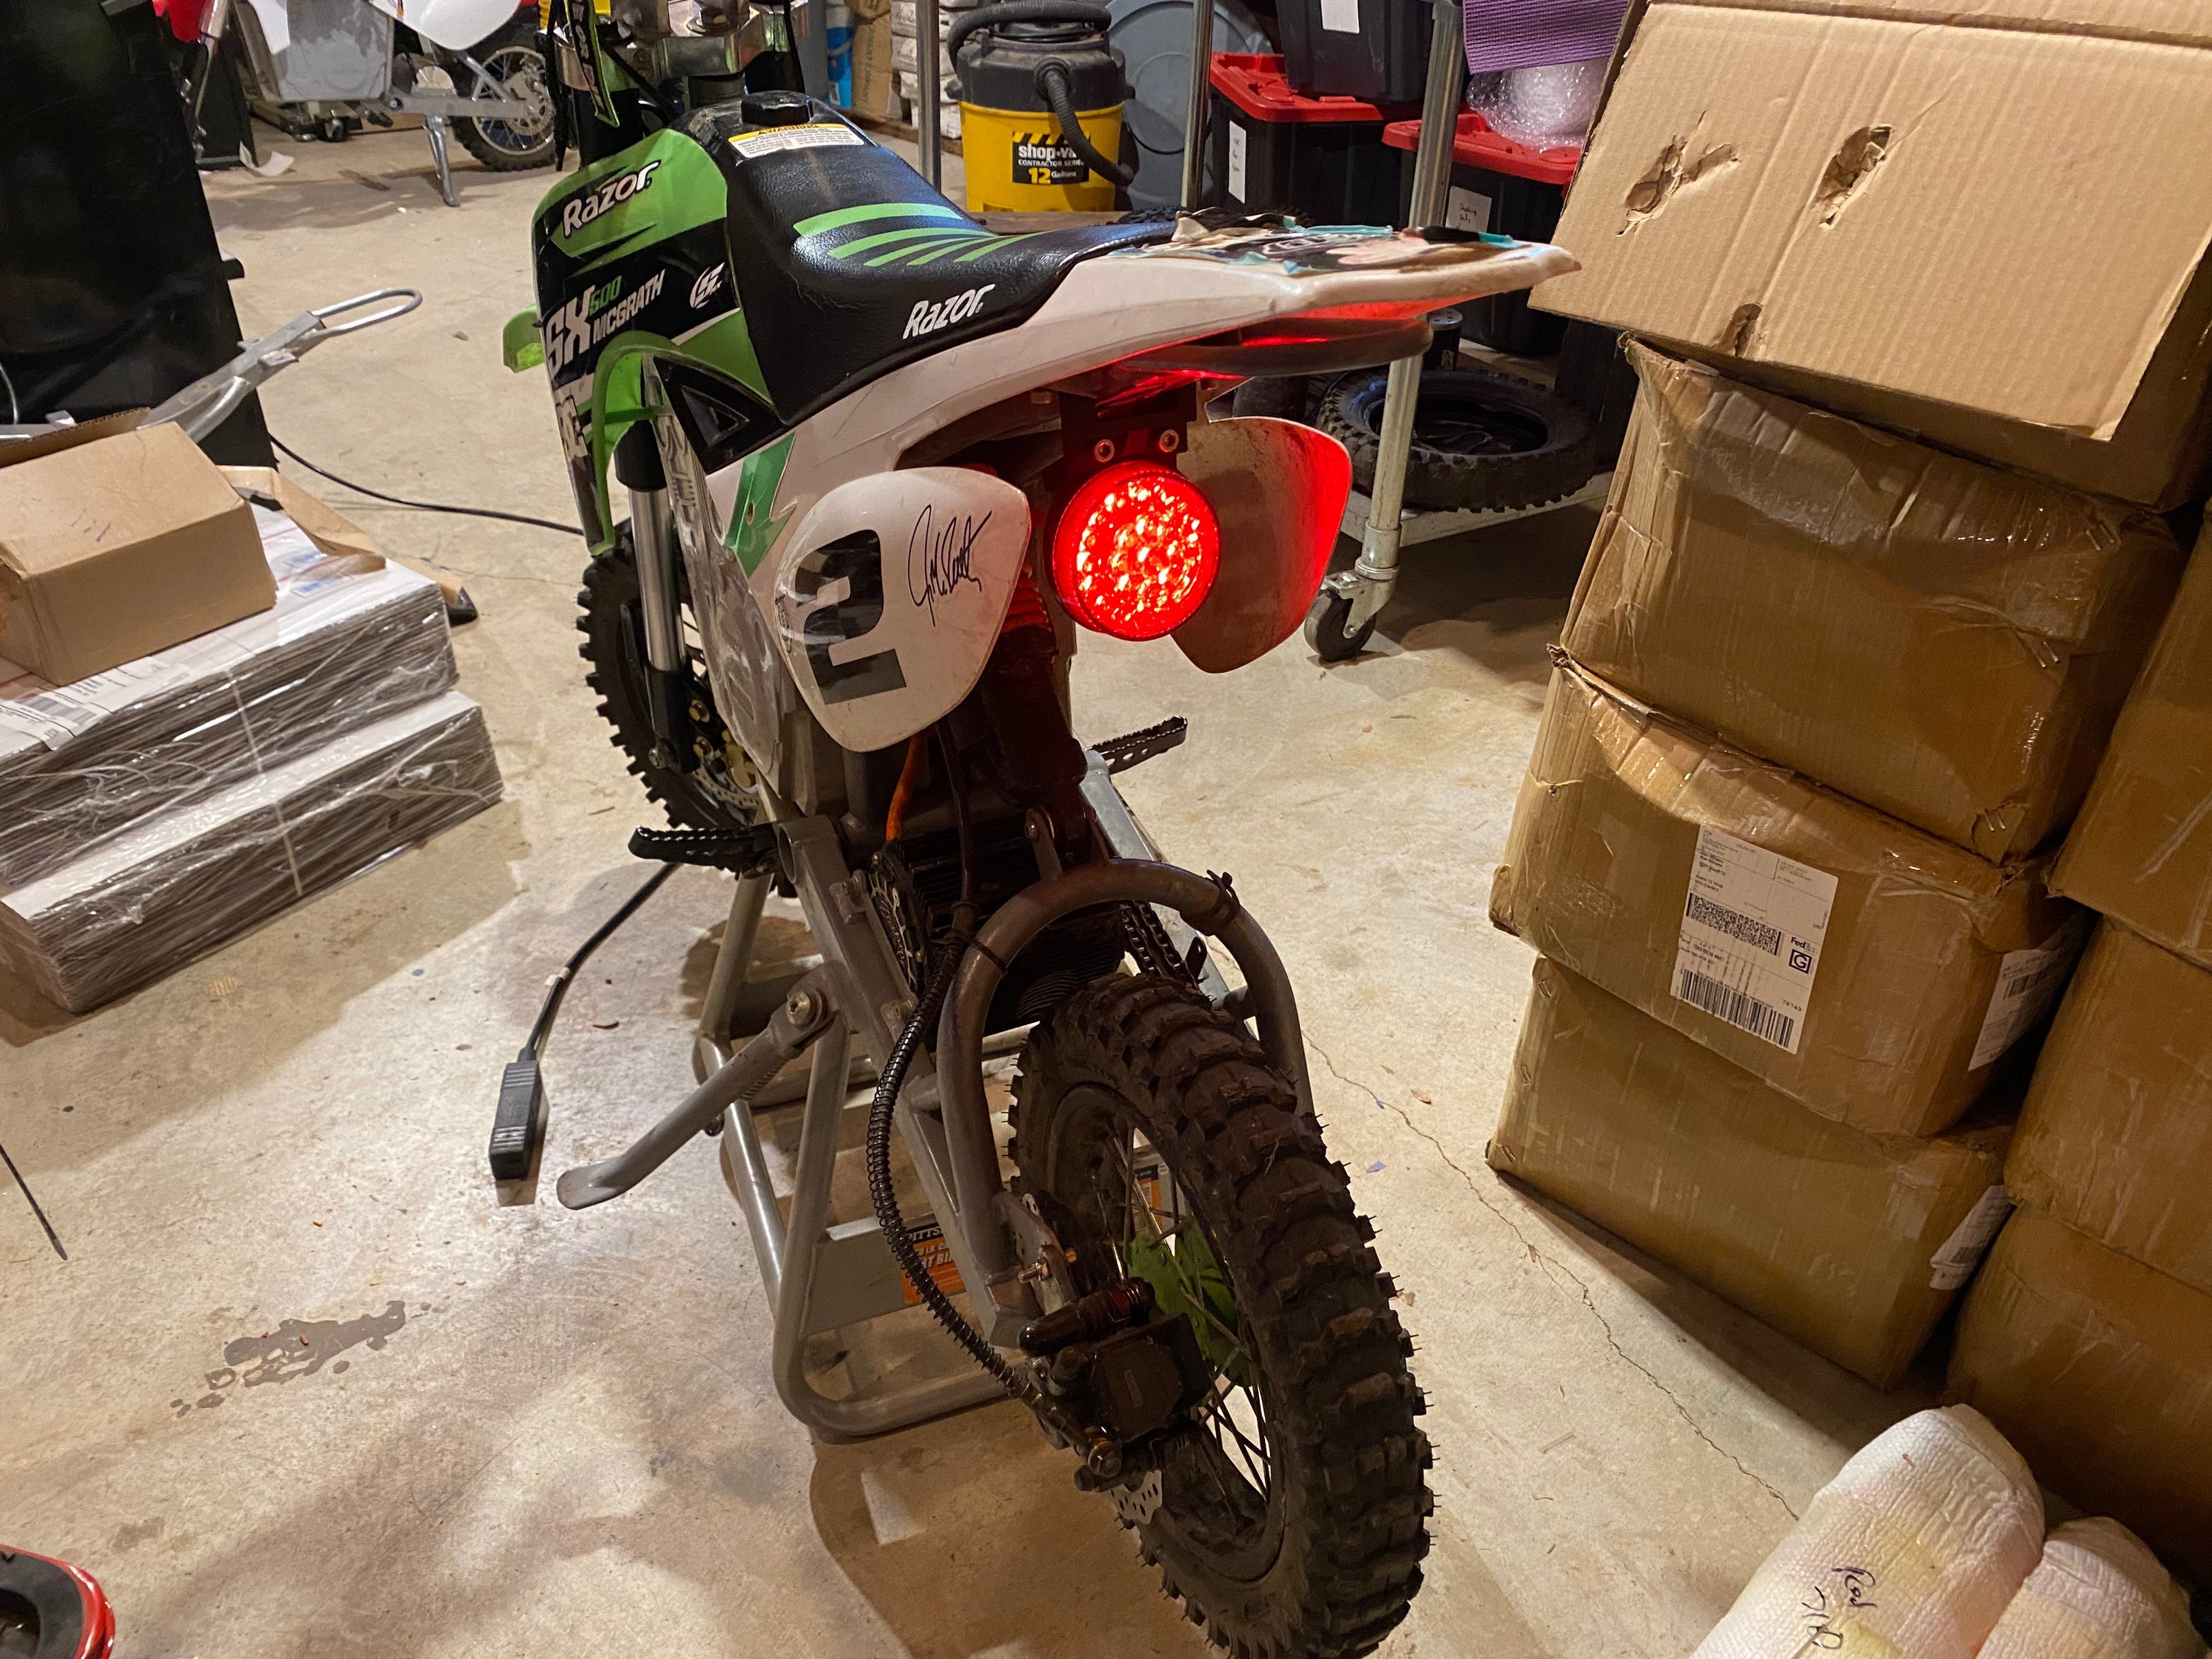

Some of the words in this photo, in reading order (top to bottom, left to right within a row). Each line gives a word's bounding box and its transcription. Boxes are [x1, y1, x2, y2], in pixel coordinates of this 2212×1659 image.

[563, 161, 659, 237] Razor
[1028, 167, 1051, 184] 12
[546, 285, 596, 379] SX
[588, 275, 622, 316] 500
[593, 268, 665, 344] MCGRATH
[903, 283, 995, 339] Razor
[1794, 955, 1808, 968] G
